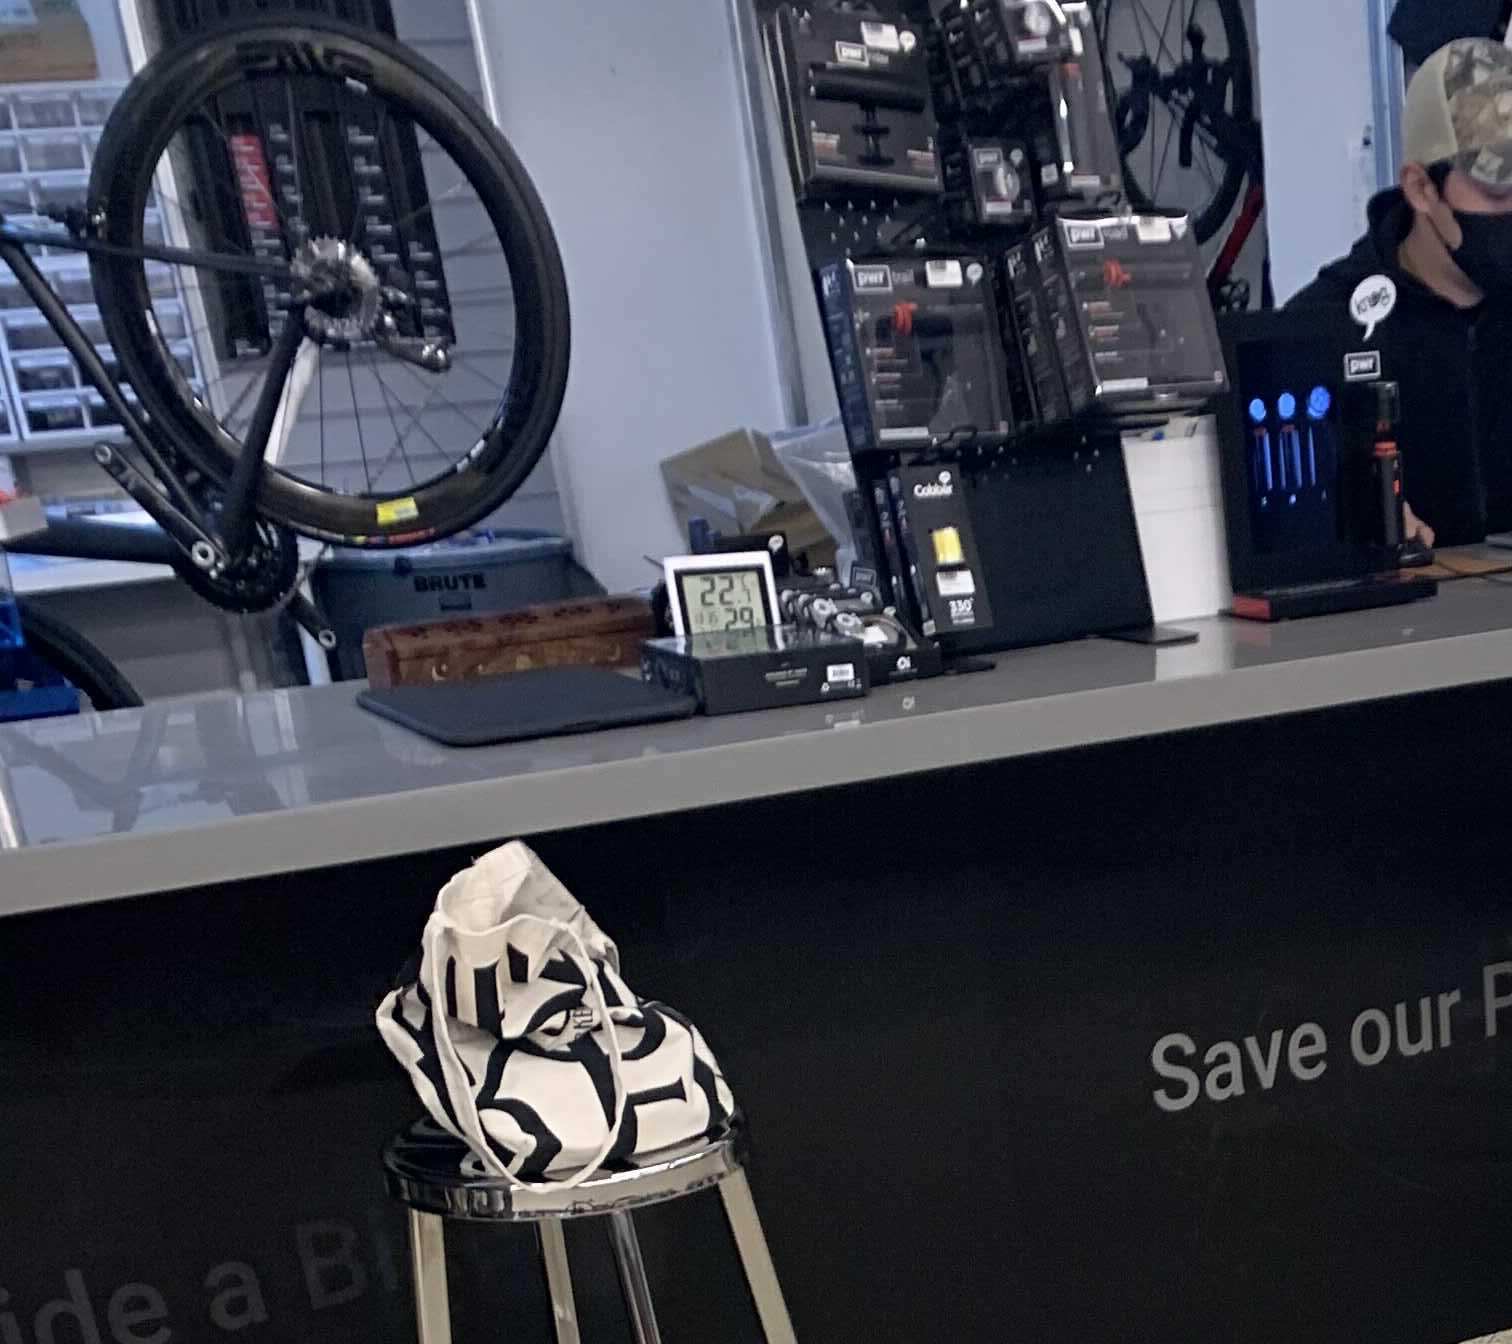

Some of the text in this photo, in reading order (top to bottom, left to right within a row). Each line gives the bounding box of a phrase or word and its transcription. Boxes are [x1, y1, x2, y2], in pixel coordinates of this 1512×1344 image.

[857, 269, 885, 287] pwr
[1350, 357, 1376, 373] pwr
[413, 573, 487, 592] BRUTE
[1151, 1032, 1328, 1112] Save
[1350, 988, 1462, 1067] our
[204, 1261, 270, 1331] a
